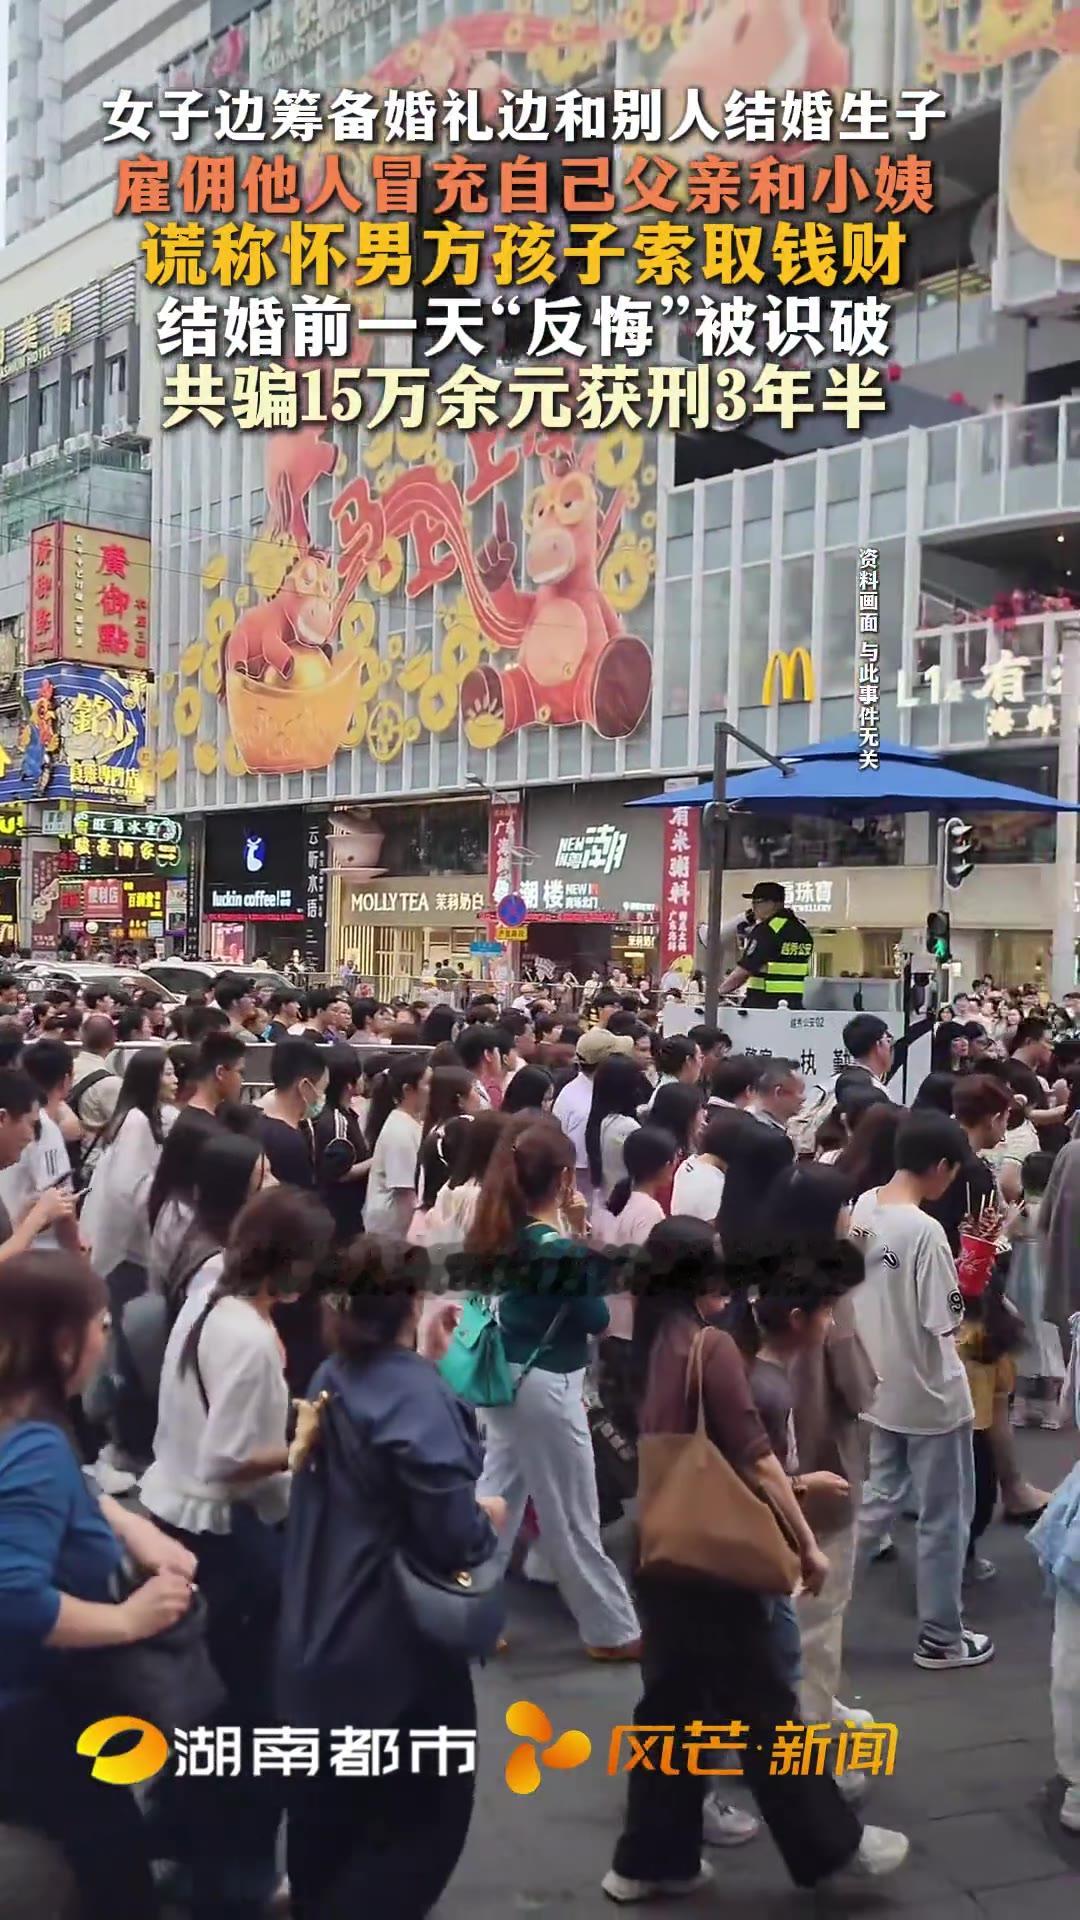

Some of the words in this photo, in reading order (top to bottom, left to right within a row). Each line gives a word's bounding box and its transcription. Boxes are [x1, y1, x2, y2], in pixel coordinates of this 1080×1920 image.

[243, 889, 277, 908] coffee
[351, 892, 399, 912] MOLLY
[399, 892, 430, 912] TEA
[435, 892, 484, 911] 茉莉奶白
